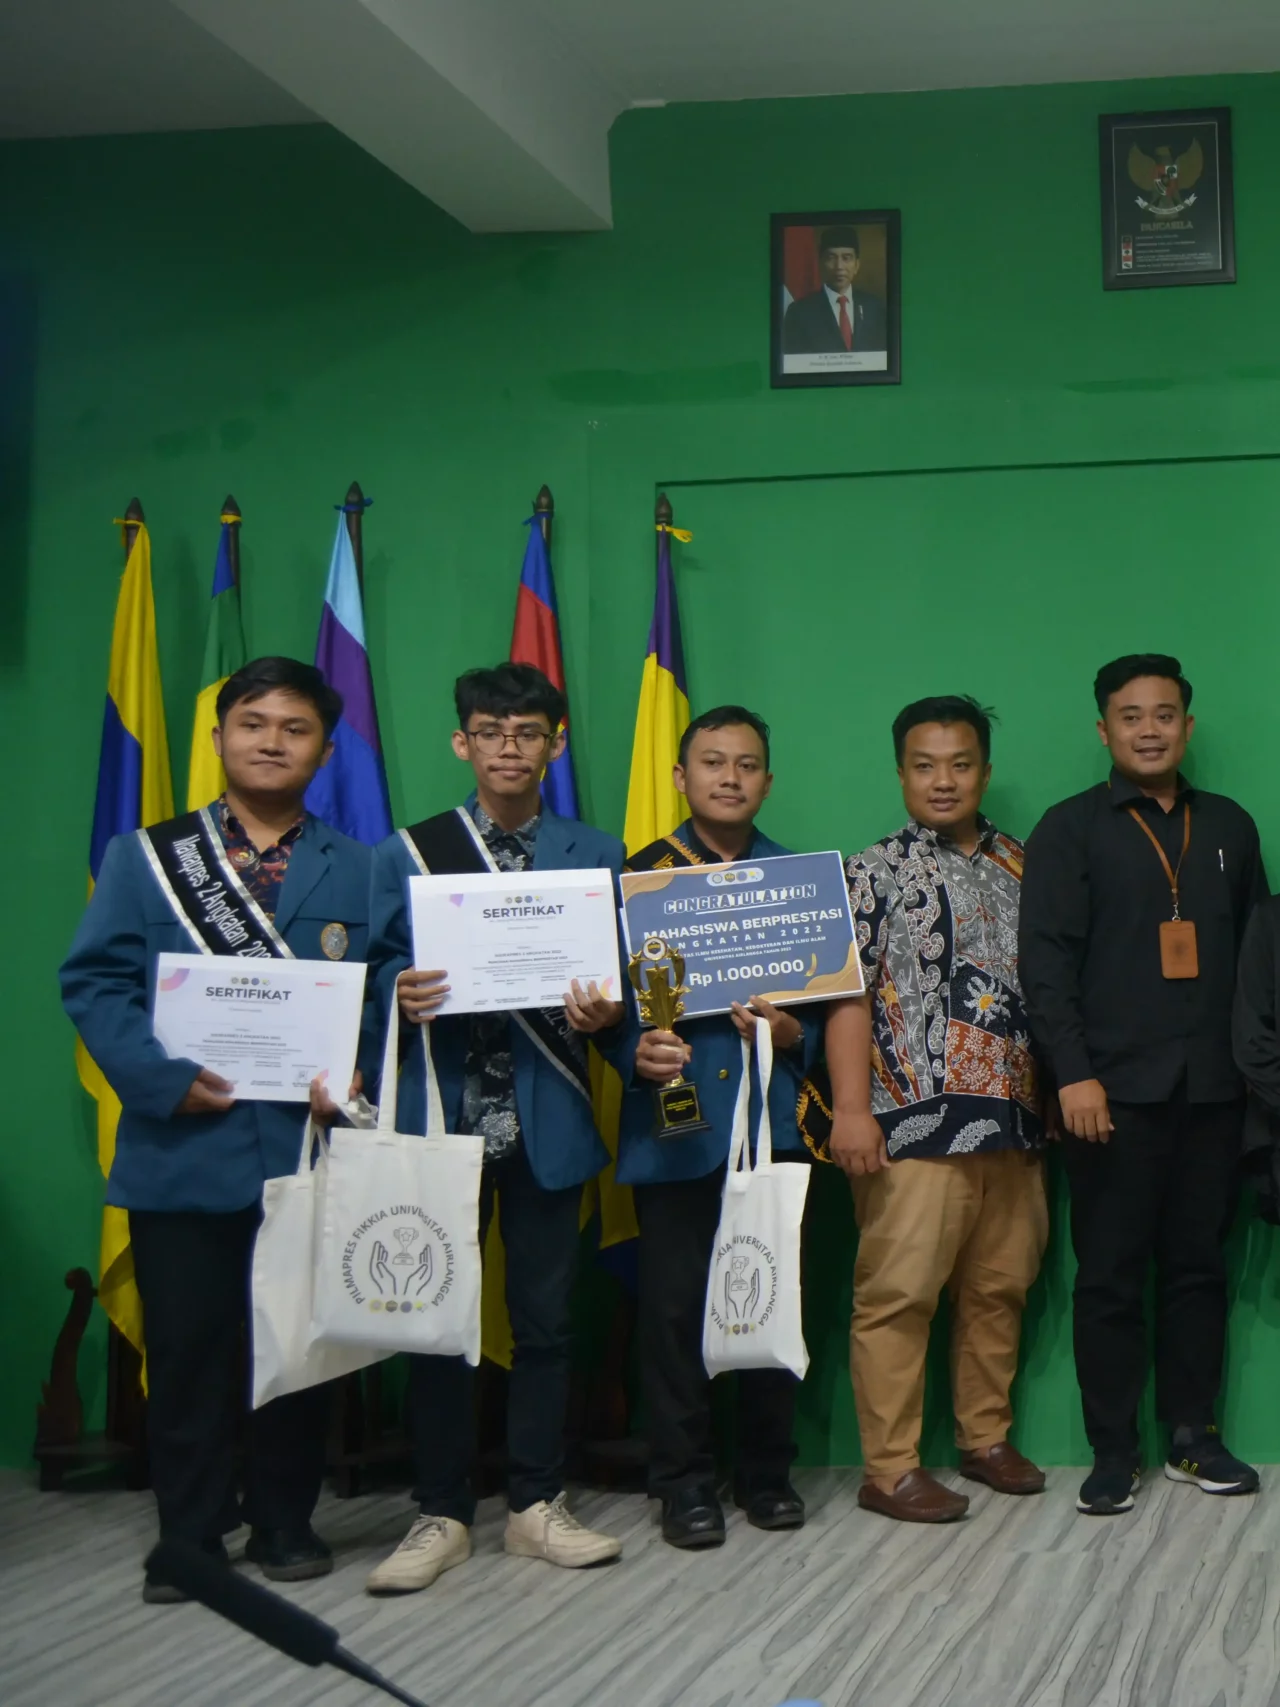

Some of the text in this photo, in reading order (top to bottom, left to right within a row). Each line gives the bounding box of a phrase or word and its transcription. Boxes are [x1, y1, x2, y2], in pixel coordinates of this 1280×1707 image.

[173, 834, 210, 887] Mawapres
[197, 881, 223, 898] 2
[664, 884, 816, 915] CONGRATULATION
[200, 890, 249, 947] Angkatan
[482, 904, 565, 919] SERTIFIKAT
[644, 908, 842, 940] MAHASISWA BERPRESTASI
[667, 925, 822, 949] NGKATAN 2022
[689, 959, 804, 987] Rp 1.000.000
[205, 986, 292, 1001] SERTIFIKAT
[352, 1210, 388, 1240] FIKKIA
[342, 1240, 366, 1305] PILMAPRES
[431, 1242, 455, 1306] AIRLANGGA
[758, 1266, 777, 1327] AIRLANGGA
